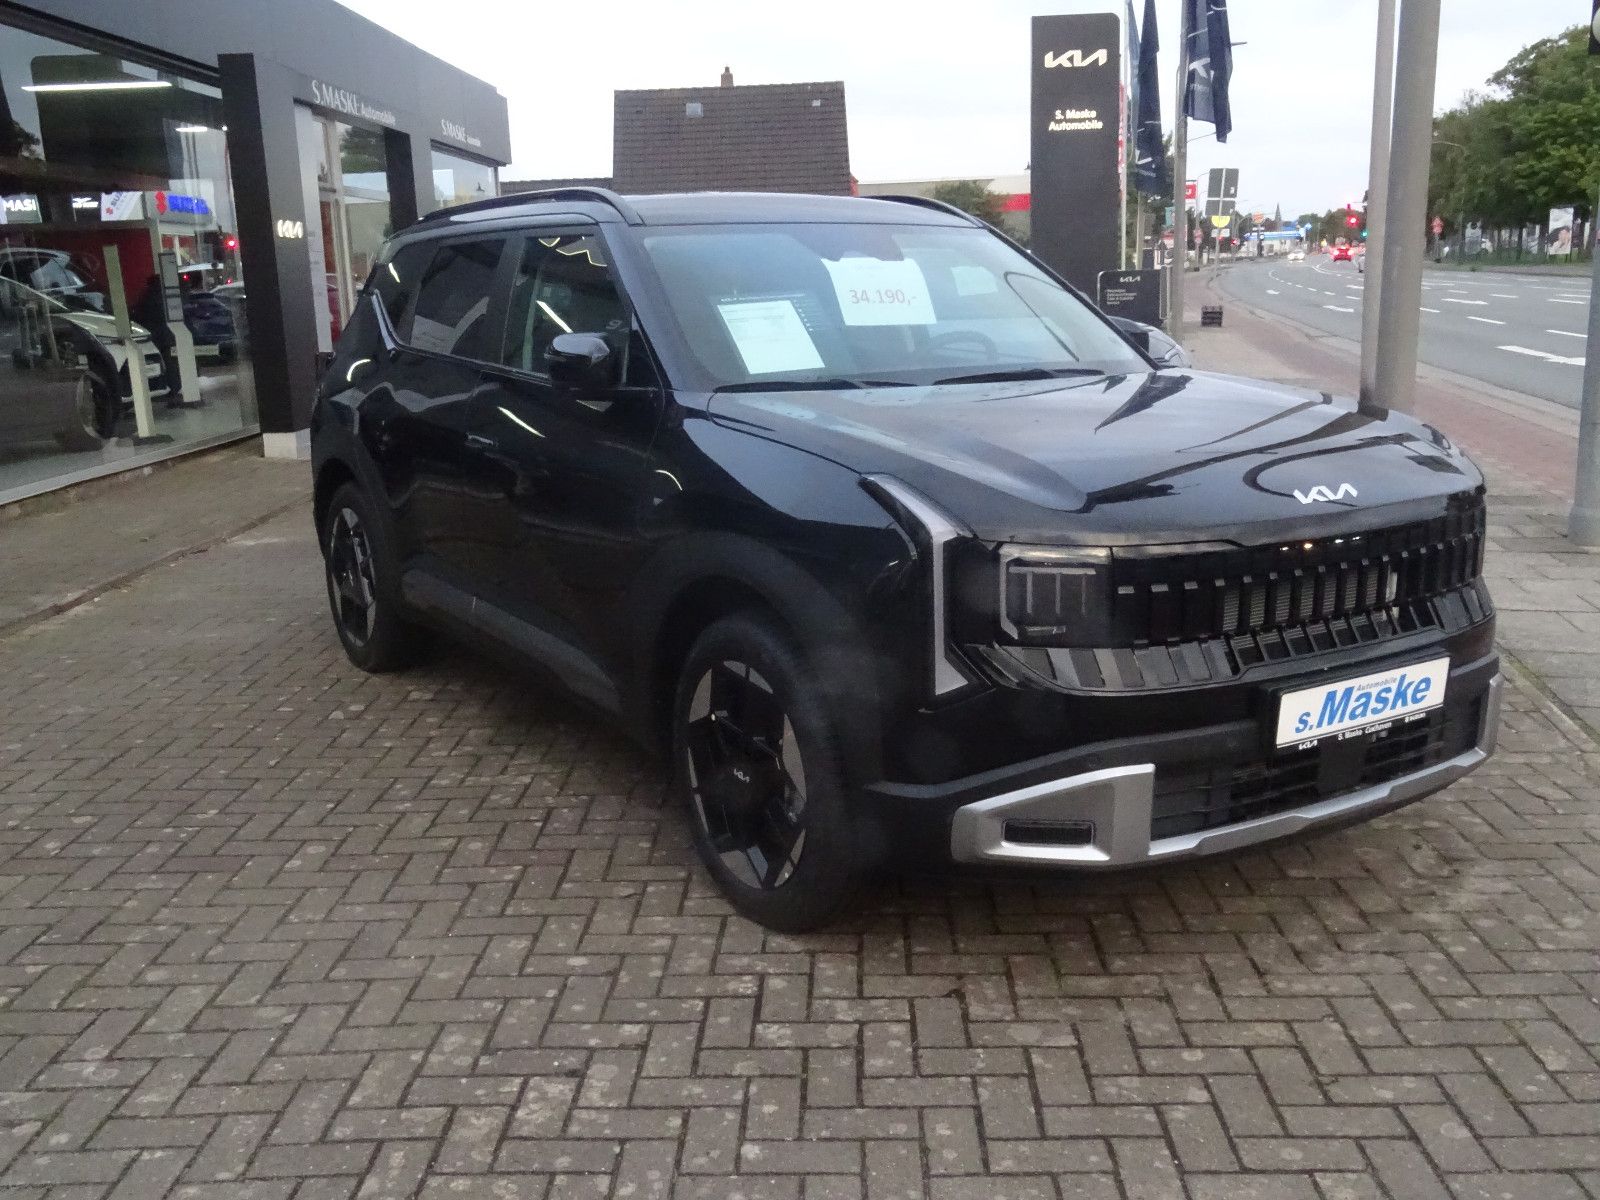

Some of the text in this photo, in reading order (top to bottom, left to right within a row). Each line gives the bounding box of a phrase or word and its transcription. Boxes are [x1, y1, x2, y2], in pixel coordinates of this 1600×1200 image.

[1044, 49, 1108, 68] KIA
[1066, 109, 1097, 119] Maske
[1048, 120, 1103, 131] Automobile
[1292, 482, 1358, 505] KIA
[1356, 676, 1398, 692] Automobile
